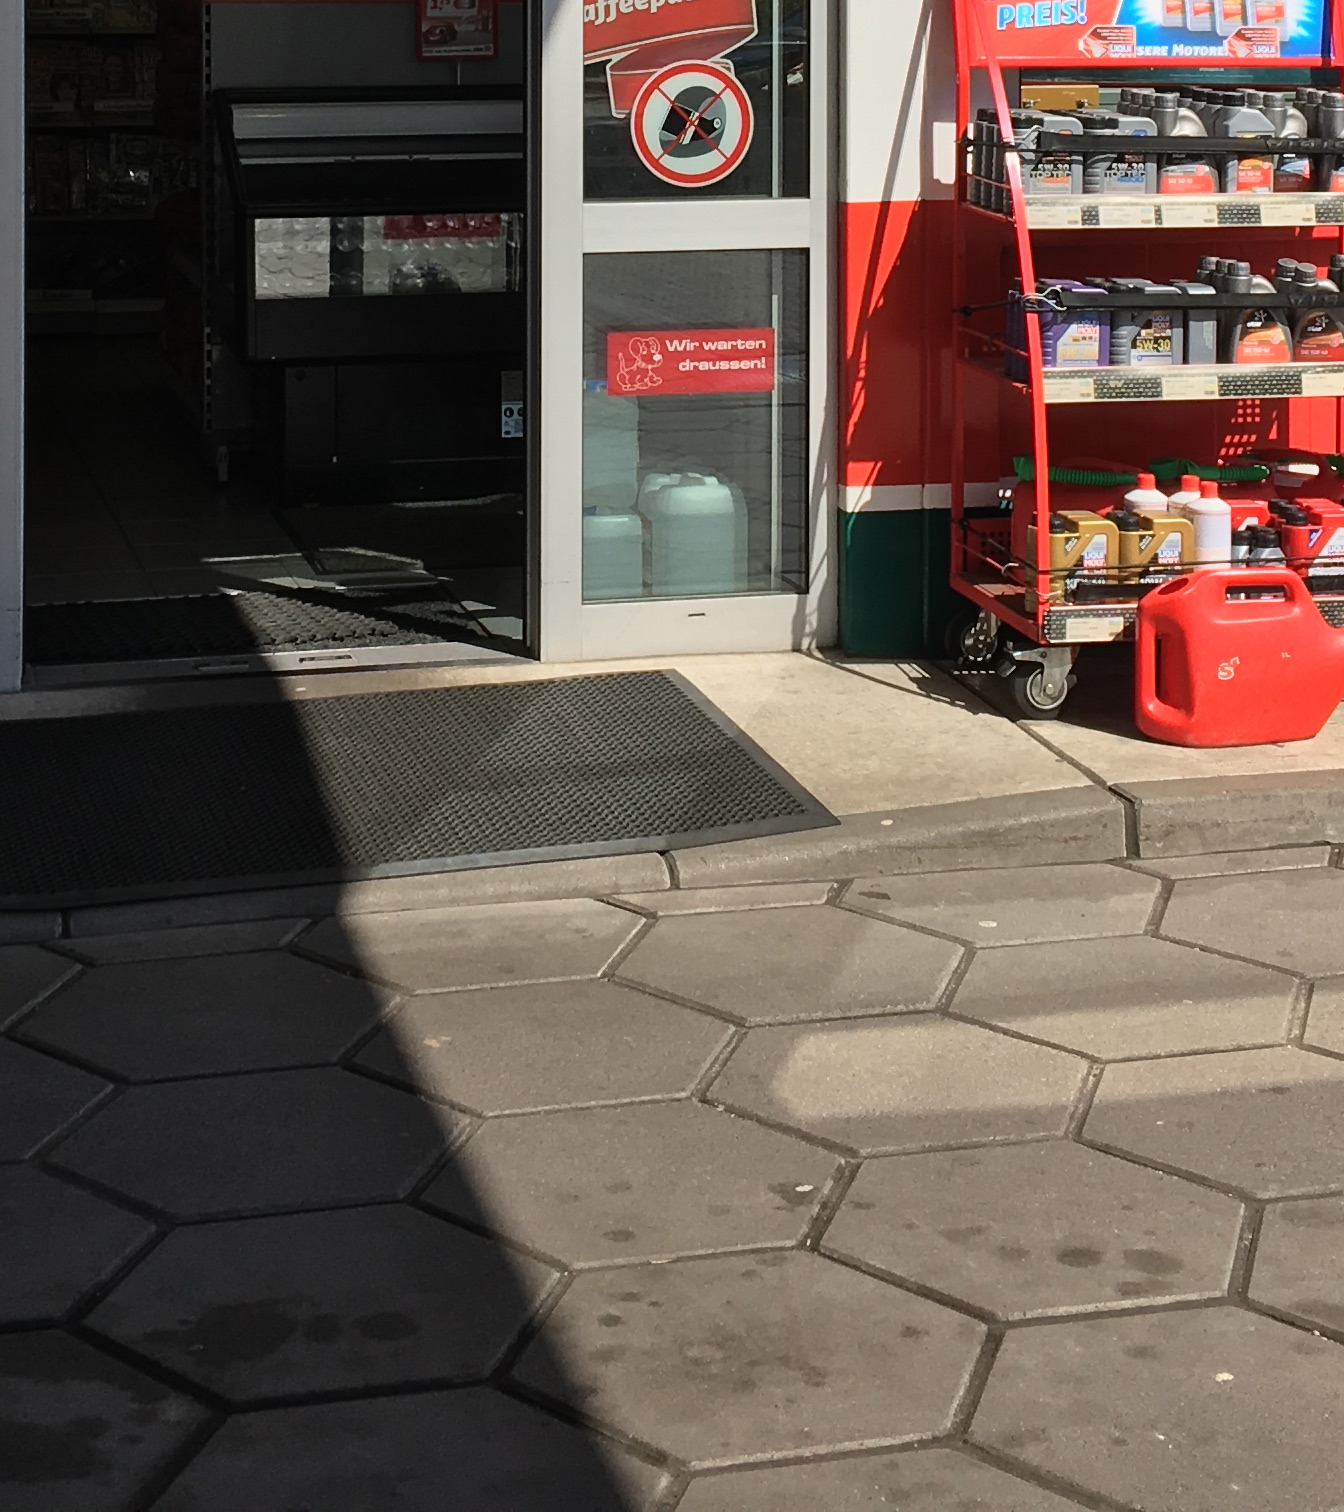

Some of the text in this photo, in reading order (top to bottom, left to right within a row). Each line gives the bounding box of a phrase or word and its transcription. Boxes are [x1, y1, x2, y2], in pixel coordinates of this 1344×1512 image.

[665, 338, 766, 352] Wir warten
[1136, 339, 1171, 352] 5W-30
[678, 356, 766, 372] draussen!
